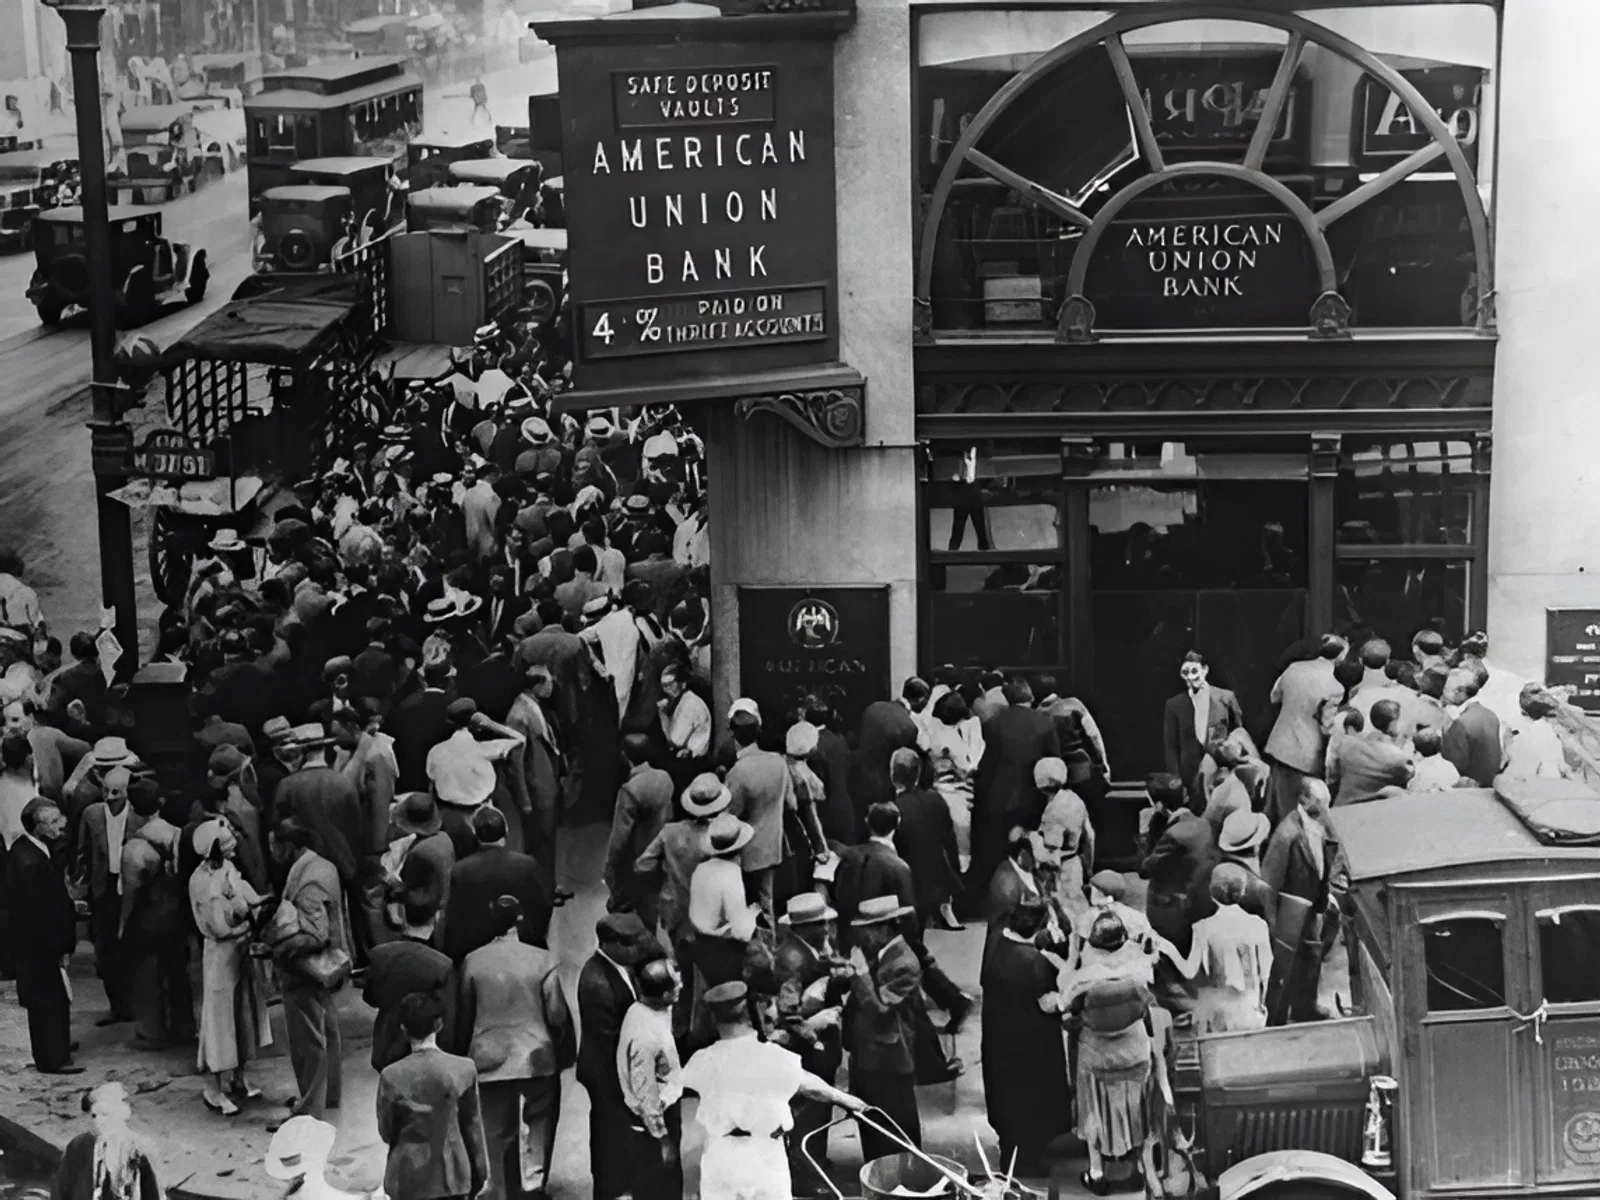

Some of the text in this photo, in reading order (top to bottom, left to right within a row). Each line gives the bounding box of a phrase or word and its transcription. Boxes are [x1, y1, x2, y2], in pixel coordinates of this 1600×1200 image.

[627, 71, 771, 95] SAFE DEPOSIT
[660, 97, 739, 118] VAULTS
[592, 129, 806, 175] AMERICAN
[629, 187, 777, 228] UNION
[1126, 223, 1281, 247] AMERICAN
[646, 244, 768, 284] BANK
[1148, 249, 1257, 273] UNION
[1163, 275, 1243, 297] BANK
[592, 307, 662, 345] 4 %
